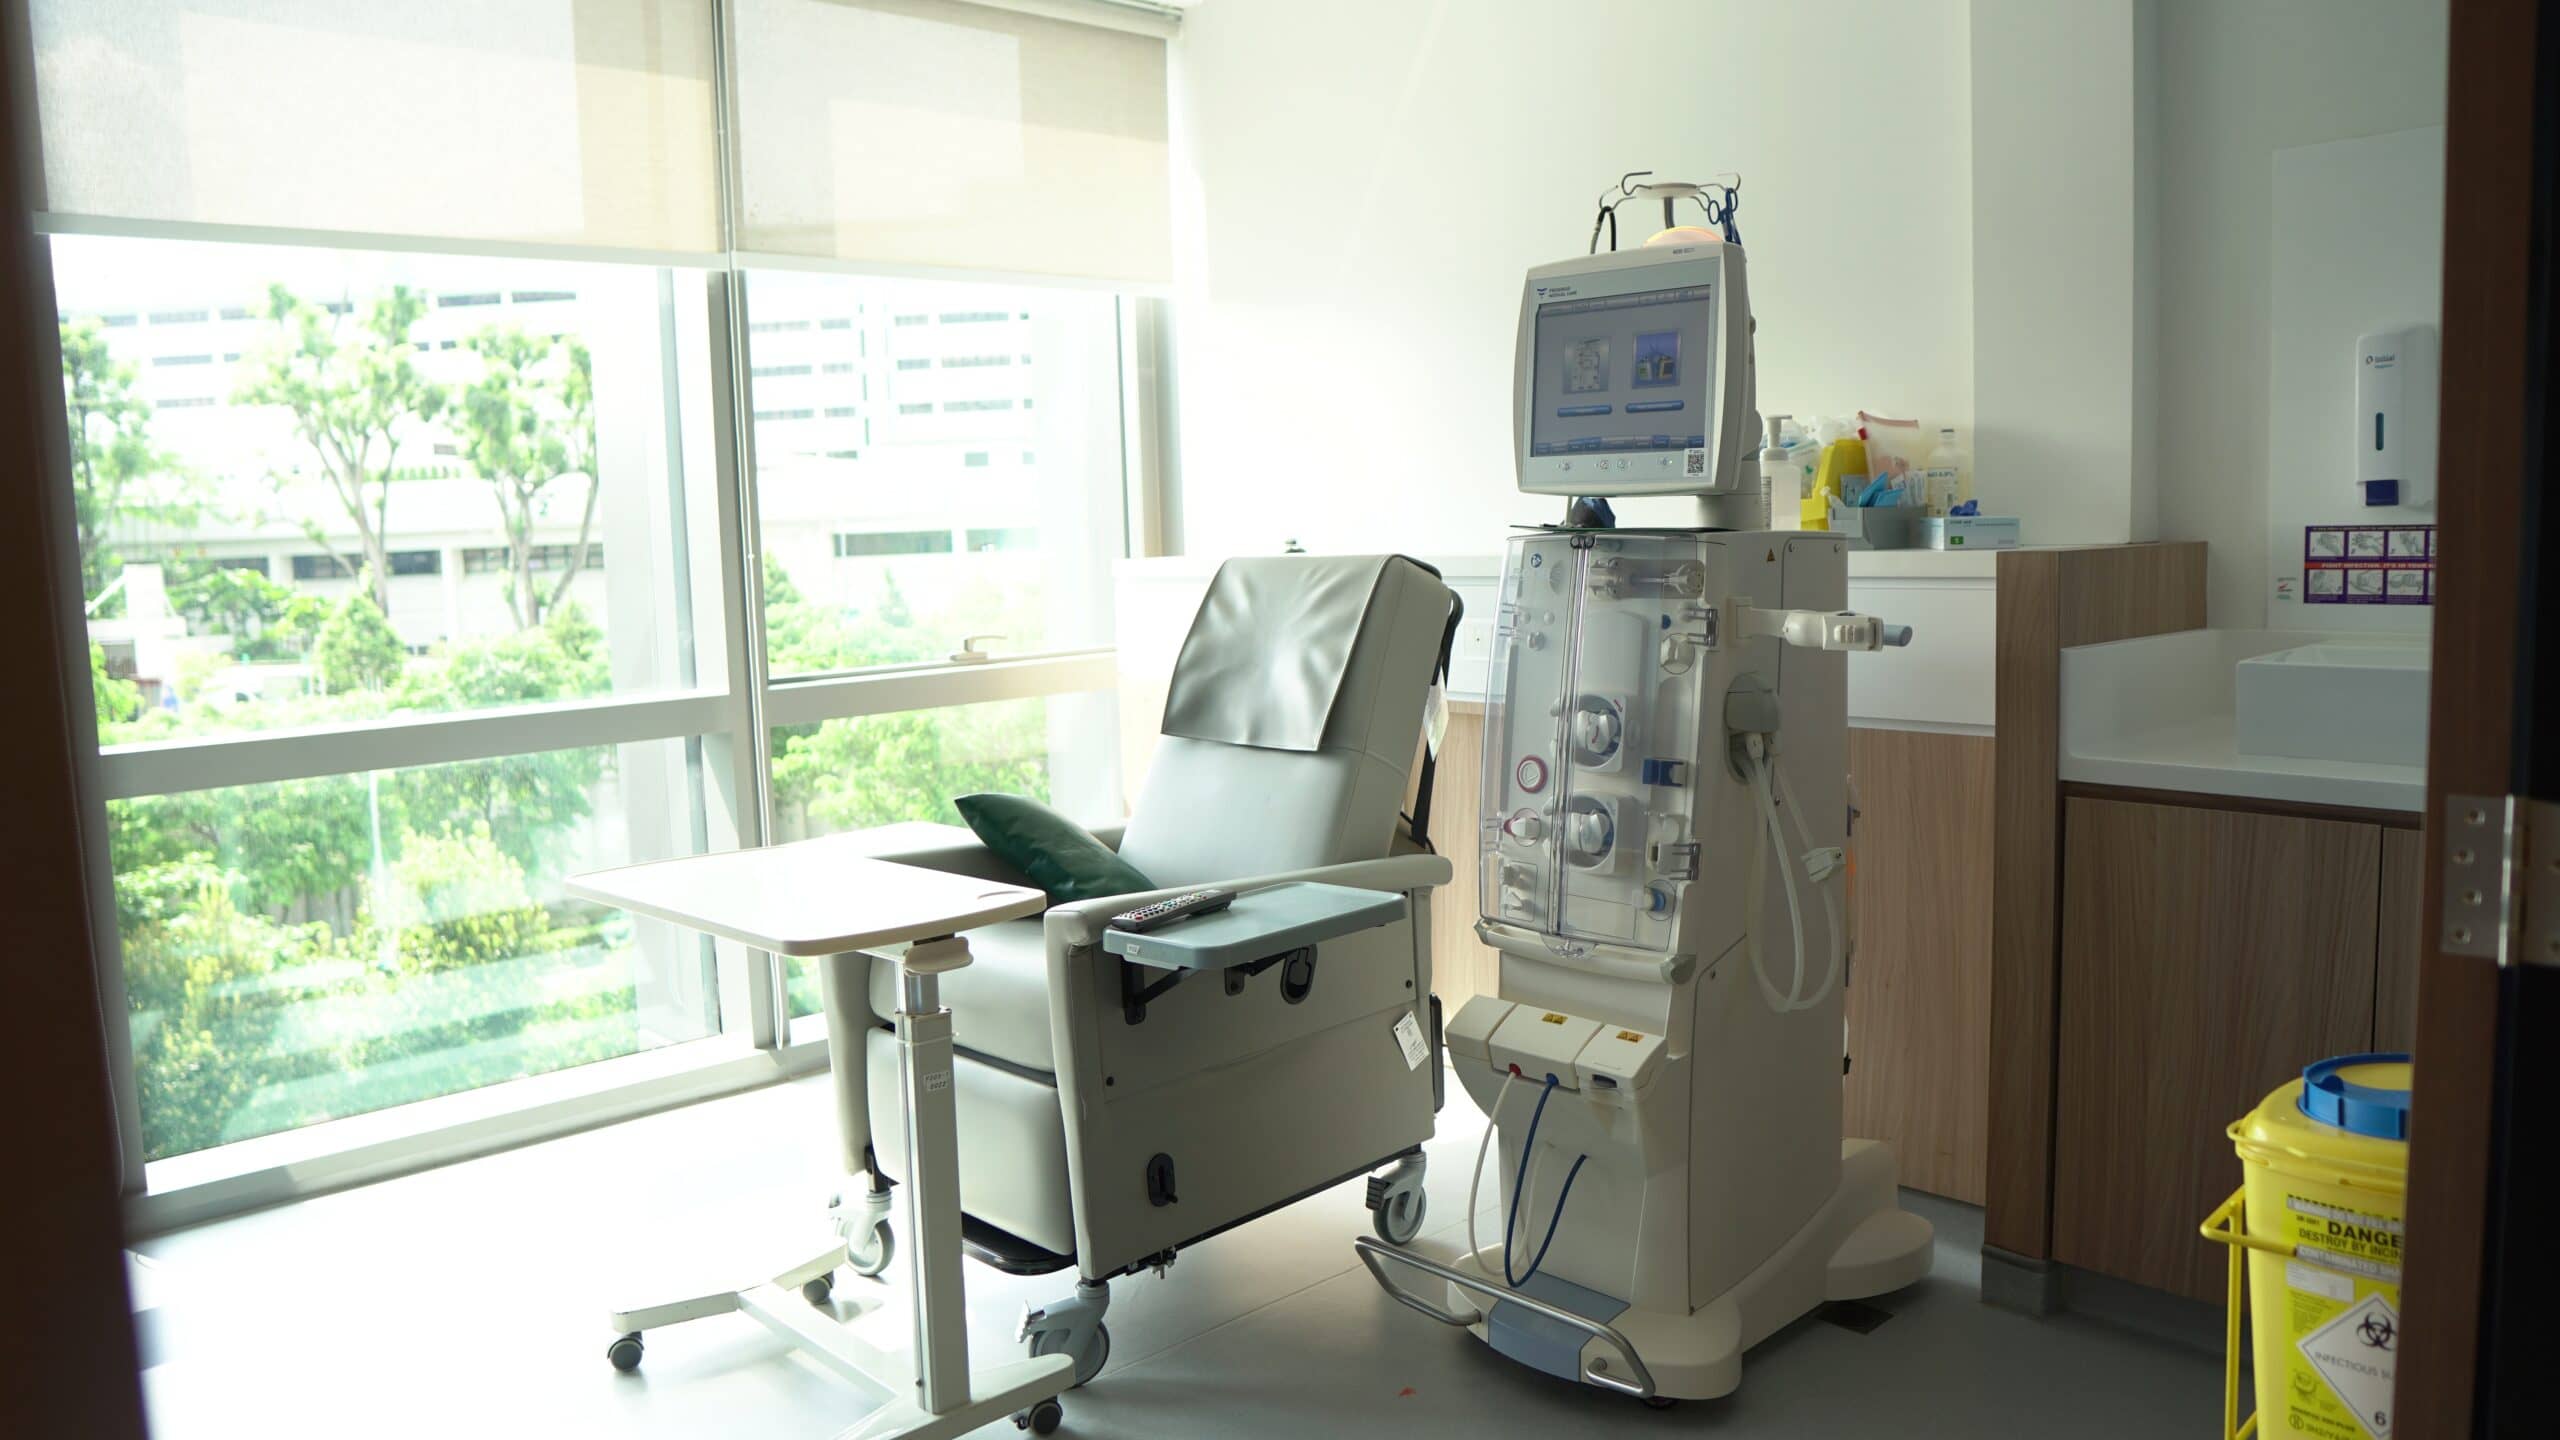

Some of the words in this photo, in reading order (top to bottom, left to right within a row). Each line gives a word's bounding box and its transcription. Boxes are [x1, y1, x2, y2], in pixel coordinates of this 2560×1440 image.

[2299, 1228, 2348, 1250] DESTROY
[2351, 1240, 2368, 1253] BY
[2328, 1221, 2403, 1248] DANGE
[2315, 1351, 2378, 1377] INFECTIOUS
[2374, 1410, 2387, 1426] 6
